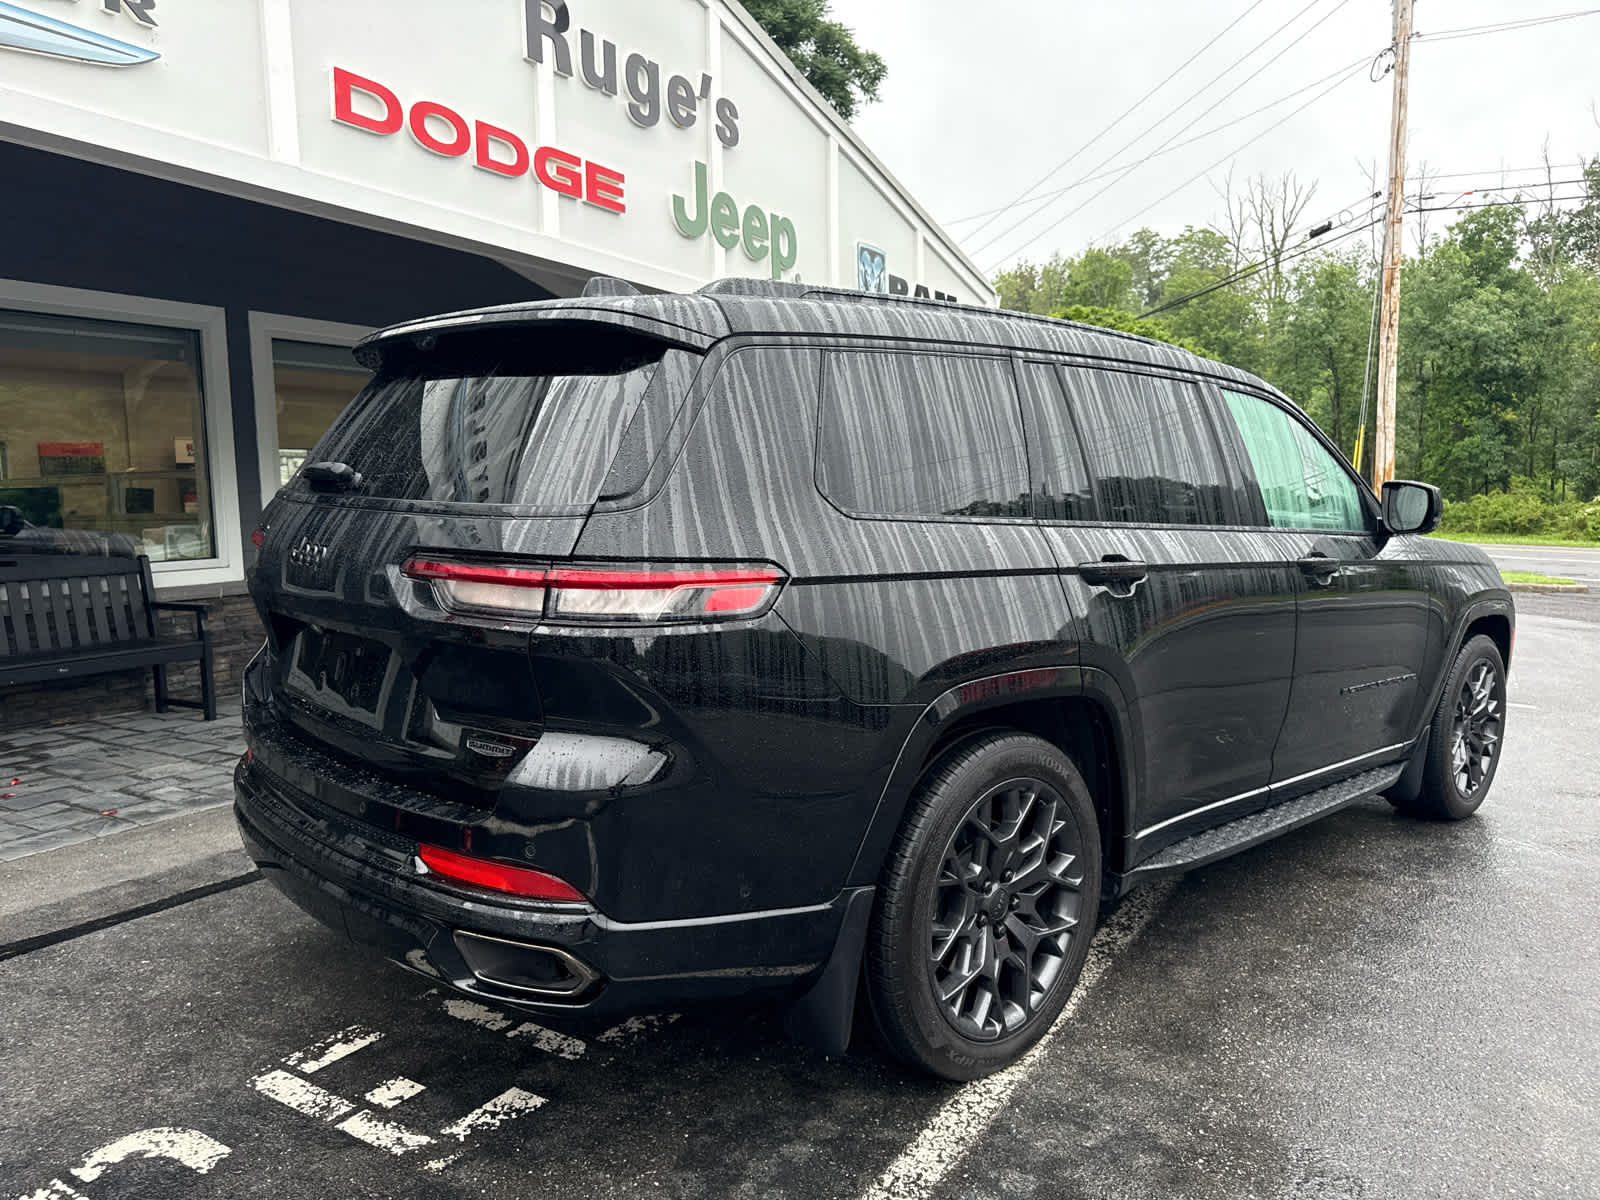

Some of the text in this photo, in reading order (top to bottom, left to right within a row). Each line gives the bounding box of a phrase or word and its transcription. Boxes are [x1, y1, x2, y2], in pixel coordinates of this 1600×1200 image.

[332, 66, 626, 215] DODGE
[524, 0, 740, 148] Ruge's
[672, 159, 798, 281] Jeep
